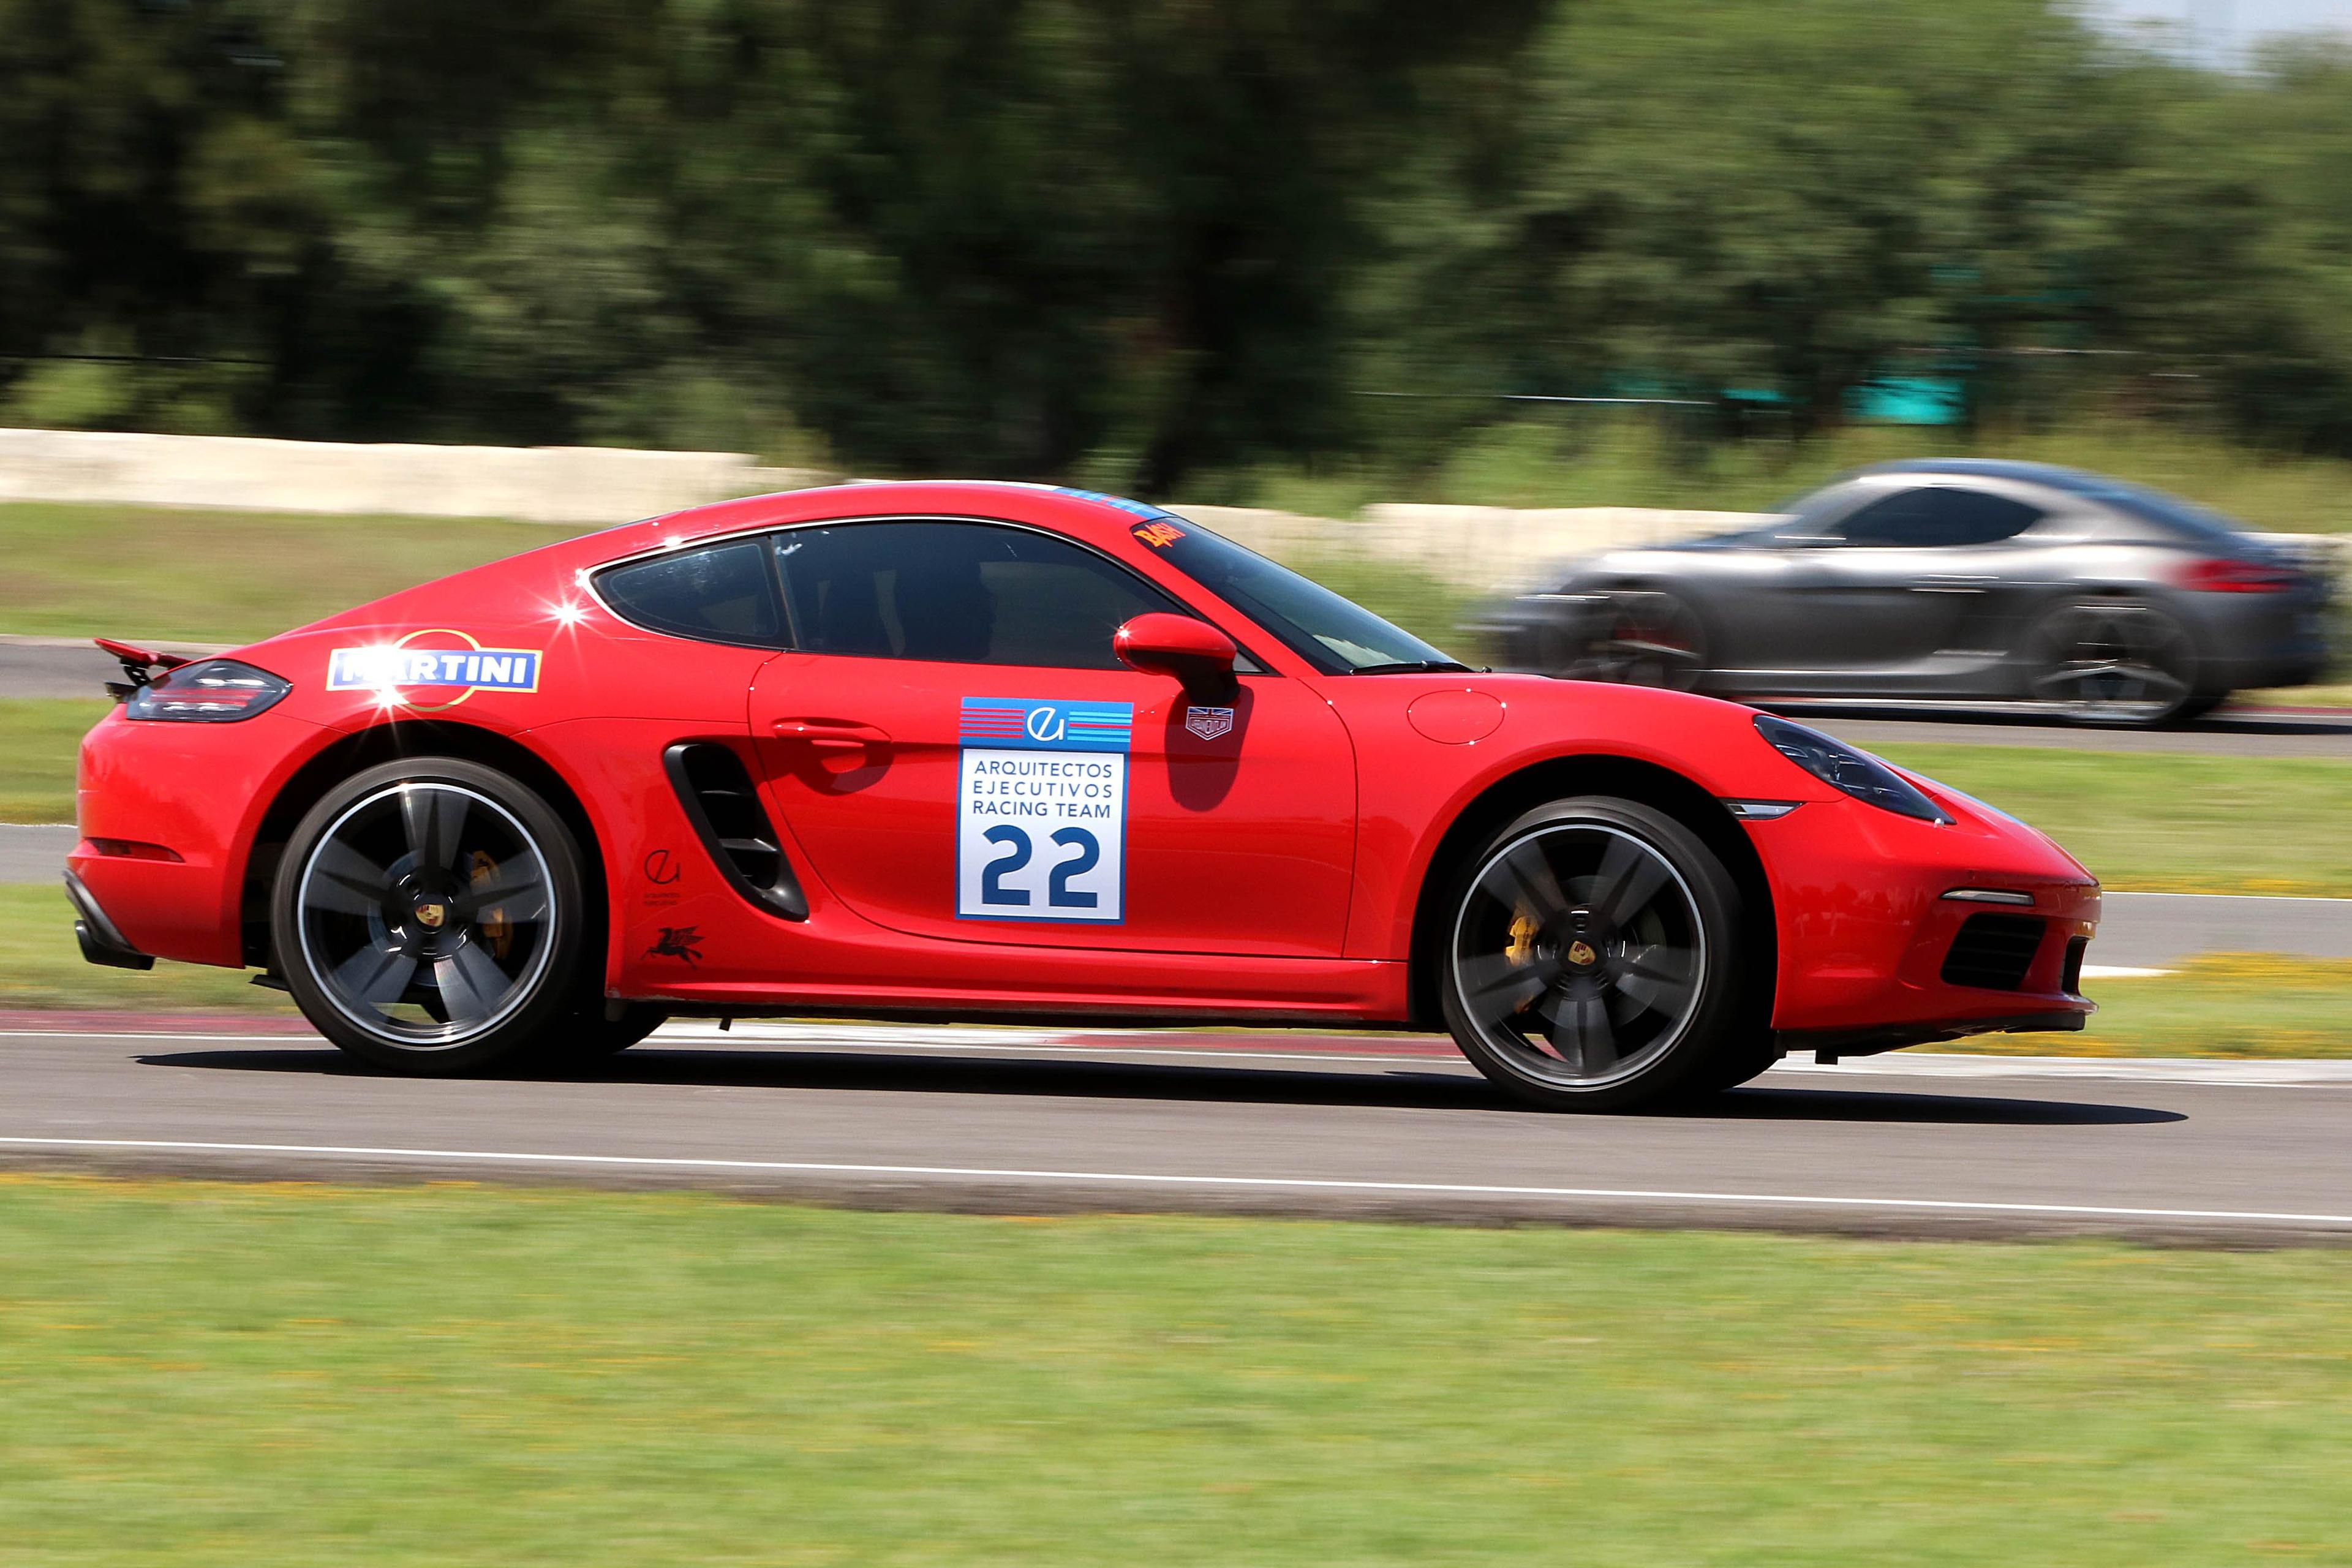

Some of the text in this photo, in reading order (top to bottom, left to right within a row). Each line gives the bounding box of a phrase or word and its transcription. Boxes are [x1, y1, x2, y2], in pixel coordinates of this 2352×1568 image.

[1133, 522, 1186, 548] BASH
[974, 761, 1112, 778] ARQUITECTOS
[973, 780, 1112, 798] EJECUTIVOS
[973, 801, 1110, 819] RACING TEAM
[981, 824, 1100, 908] 22
